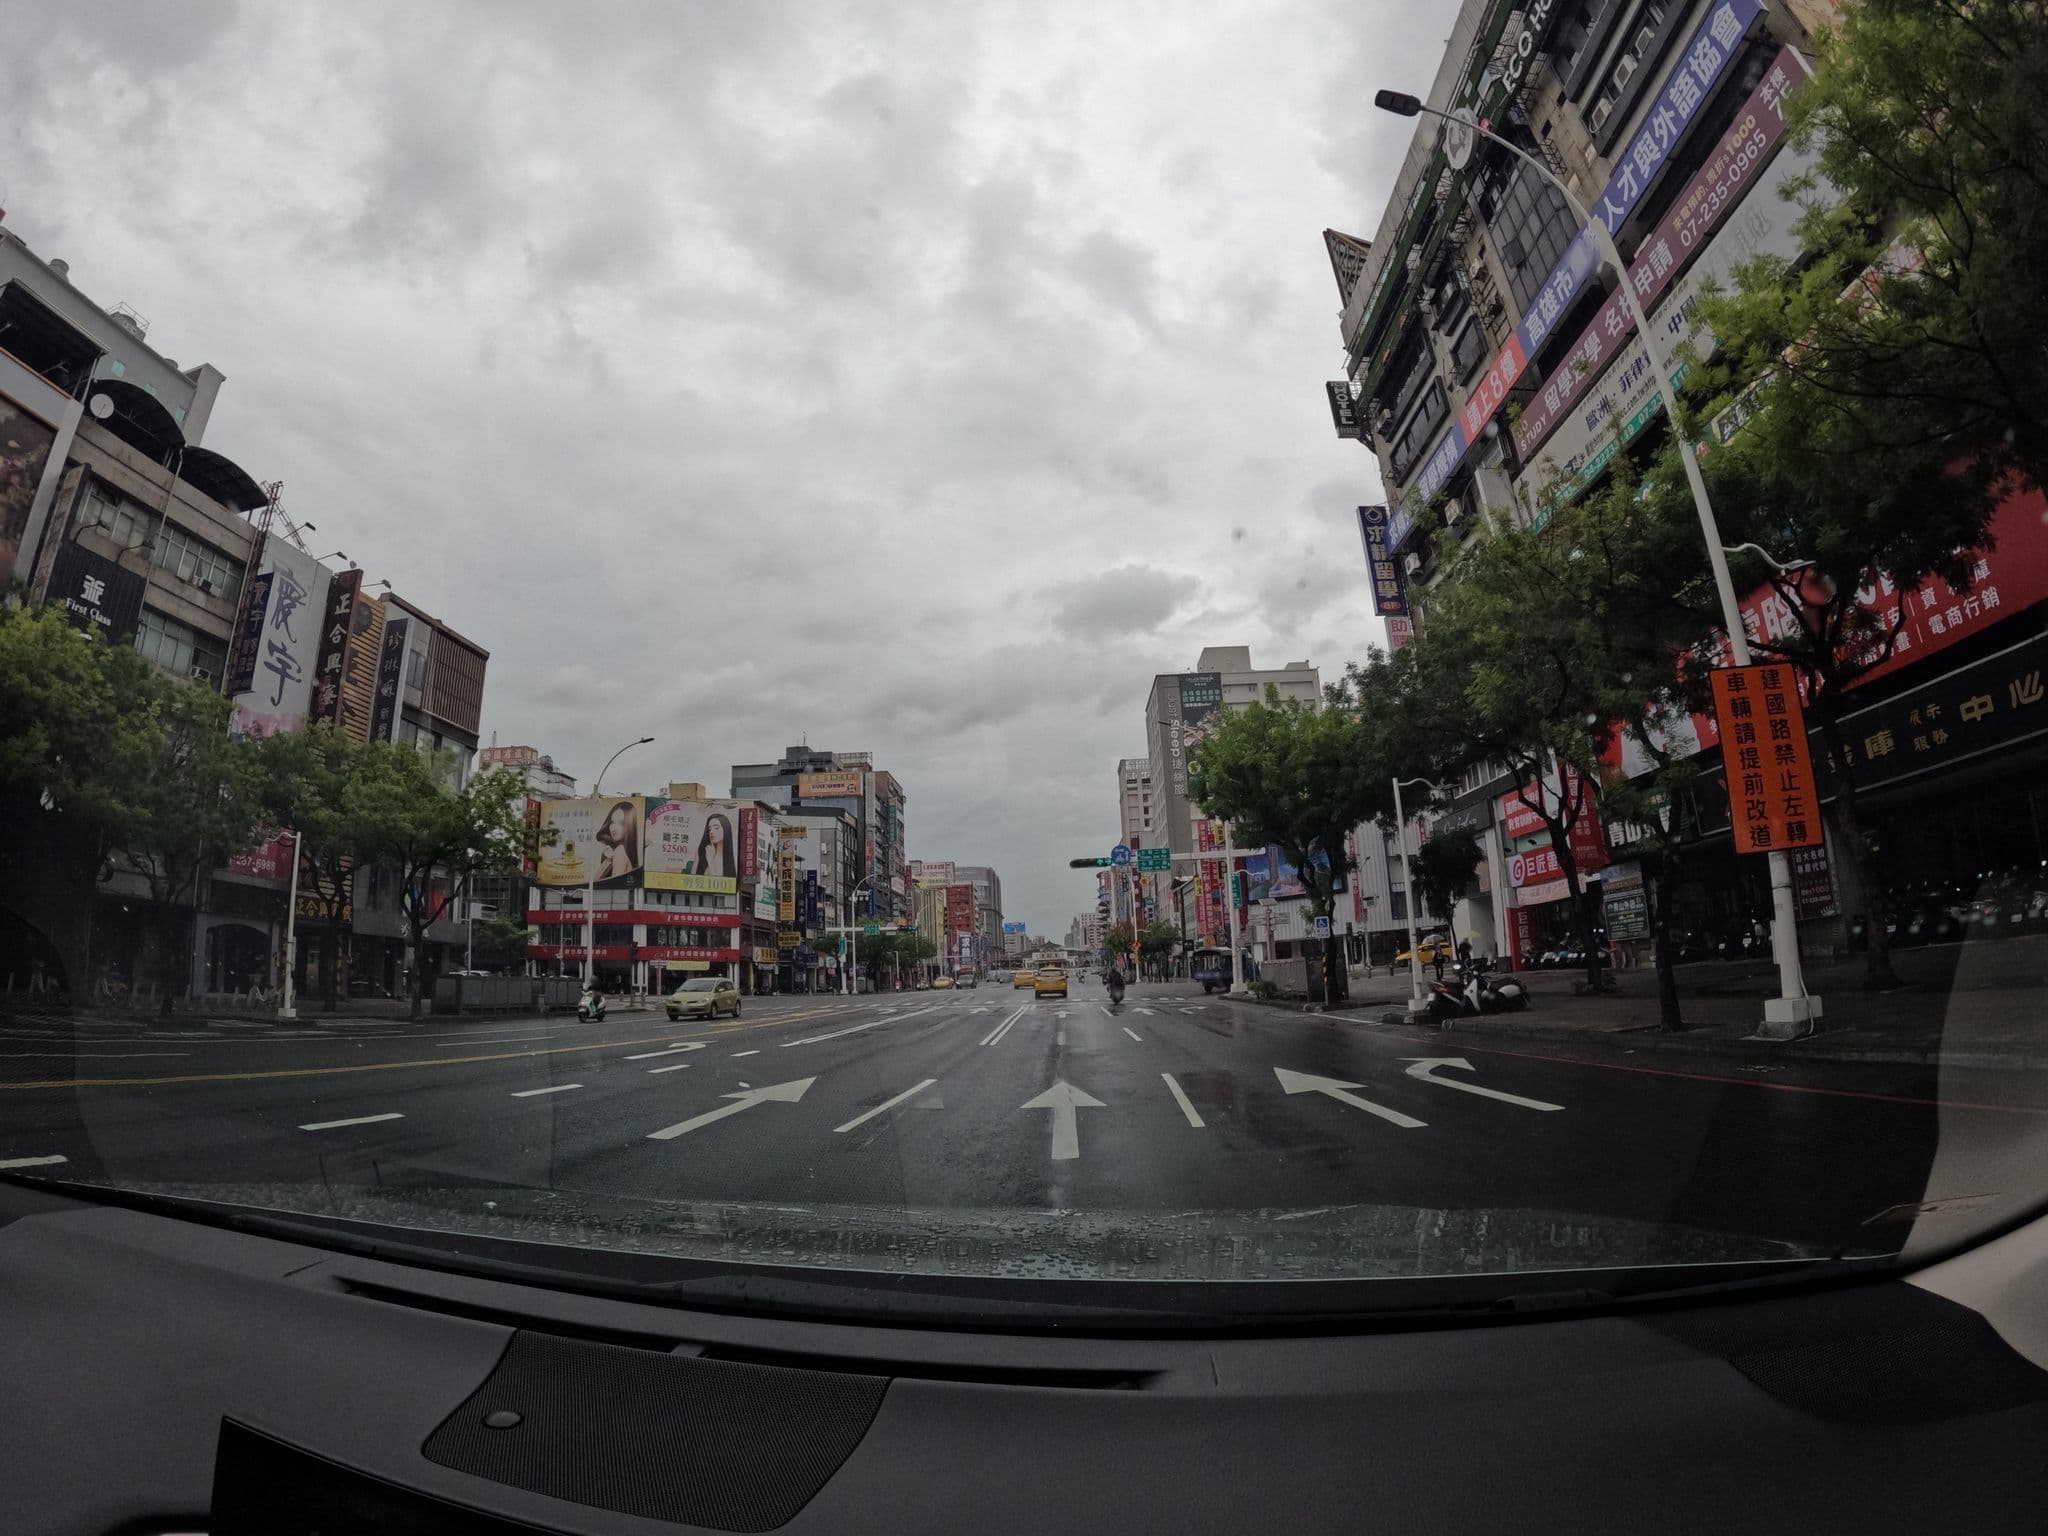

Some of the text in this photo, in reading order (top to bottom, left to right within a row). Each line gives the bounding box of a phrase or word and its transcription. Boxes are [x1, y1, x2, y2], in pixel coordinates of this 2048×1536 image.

[1502, 31, 1534, 93] ECO
[1680, 128, 1767, 248] 07-235-0965
[1519, 415, 1548, 451] STUDY
[1927, 585, 2001, 636] 電商行銷
[1959, 670, 2045, 722] 中心
[1169, 718, 1181, 757] Sleep
[1726, 672, 1772, 849] 車輛請提前改道
[1760, 668, 1808, 844] 建國路禁止左轉
[662, 844, 689, 854] $2500
